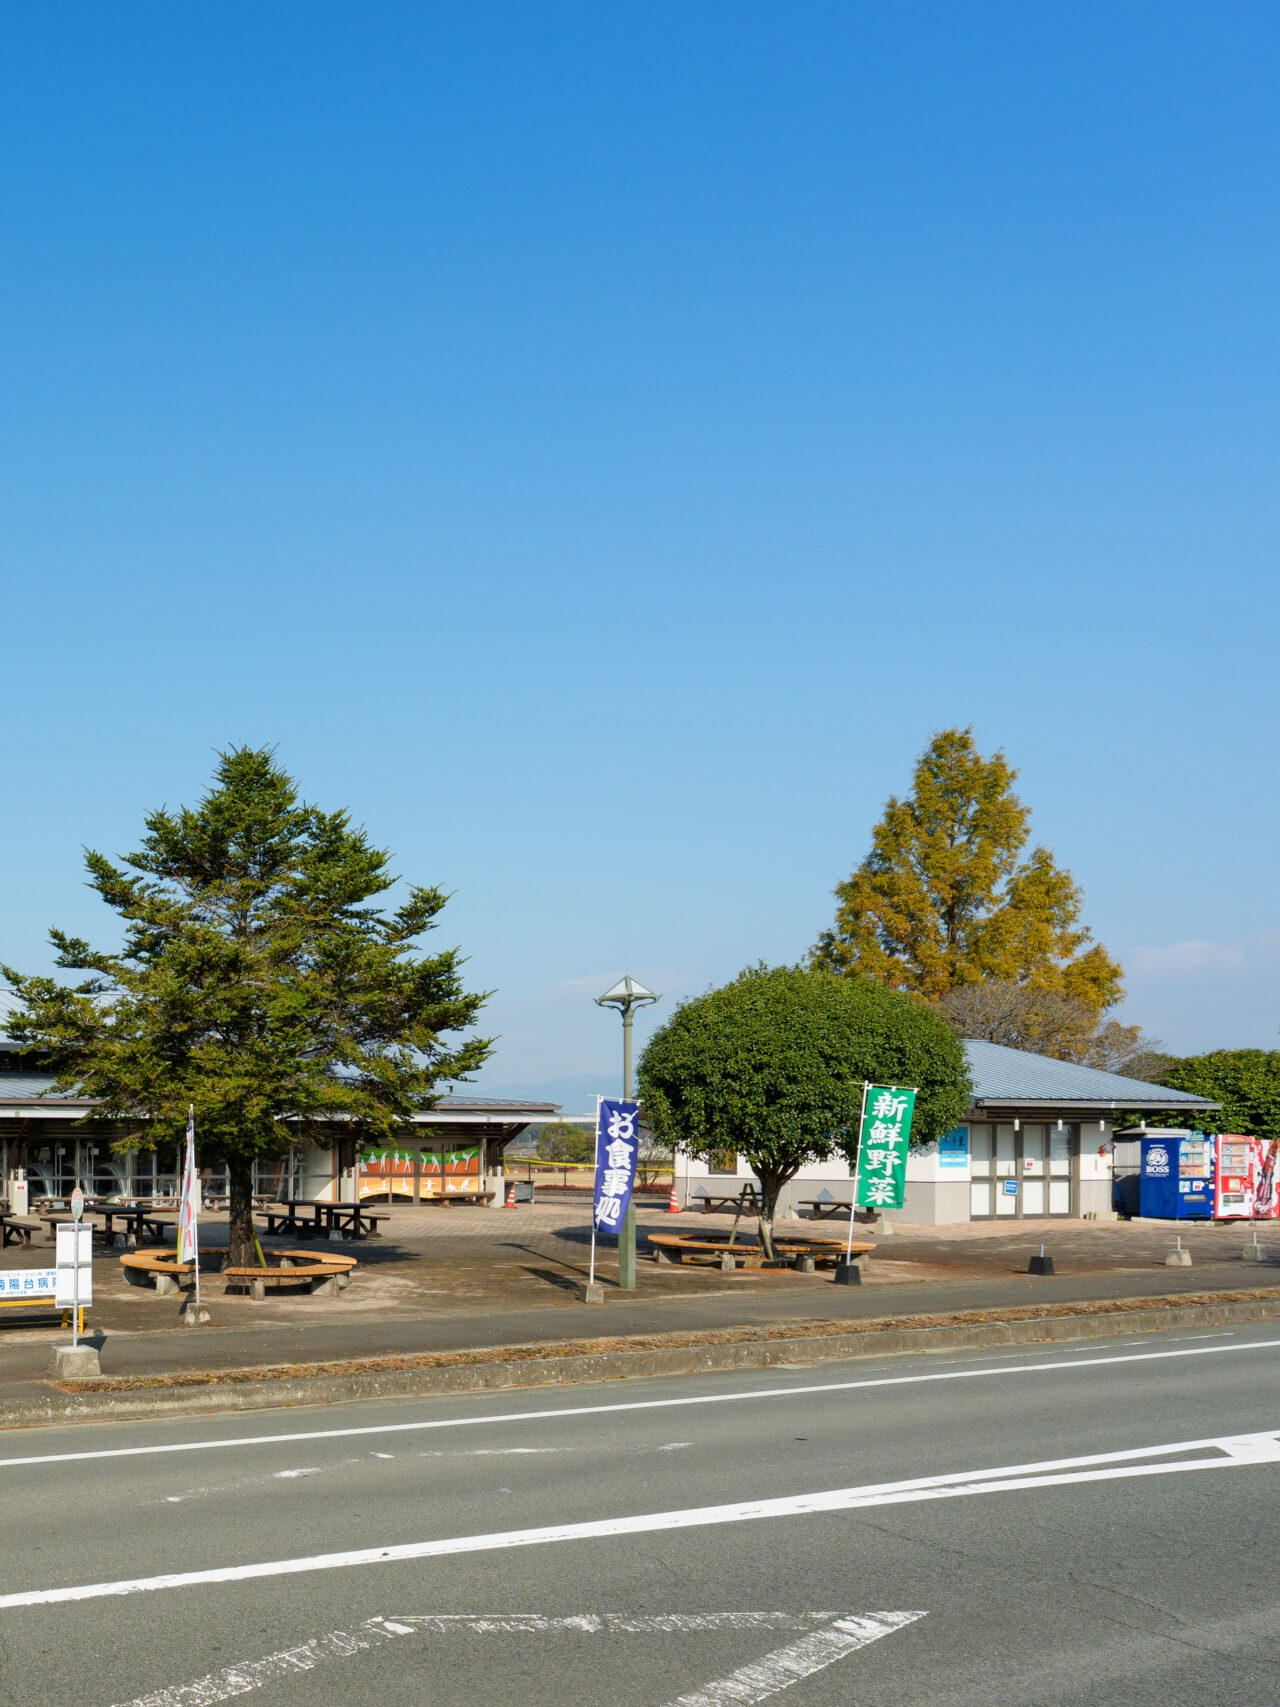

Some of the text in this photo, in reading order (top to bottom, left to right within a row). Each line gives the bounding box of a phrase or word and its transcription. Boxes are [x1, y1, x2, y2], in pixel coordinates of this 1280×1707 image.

[595, 1109, 639, 1228] お食事処
[864, 1091, 909, 1206] 新鮮野菜
[1145, 1165, 1170, 1173] BOSS
